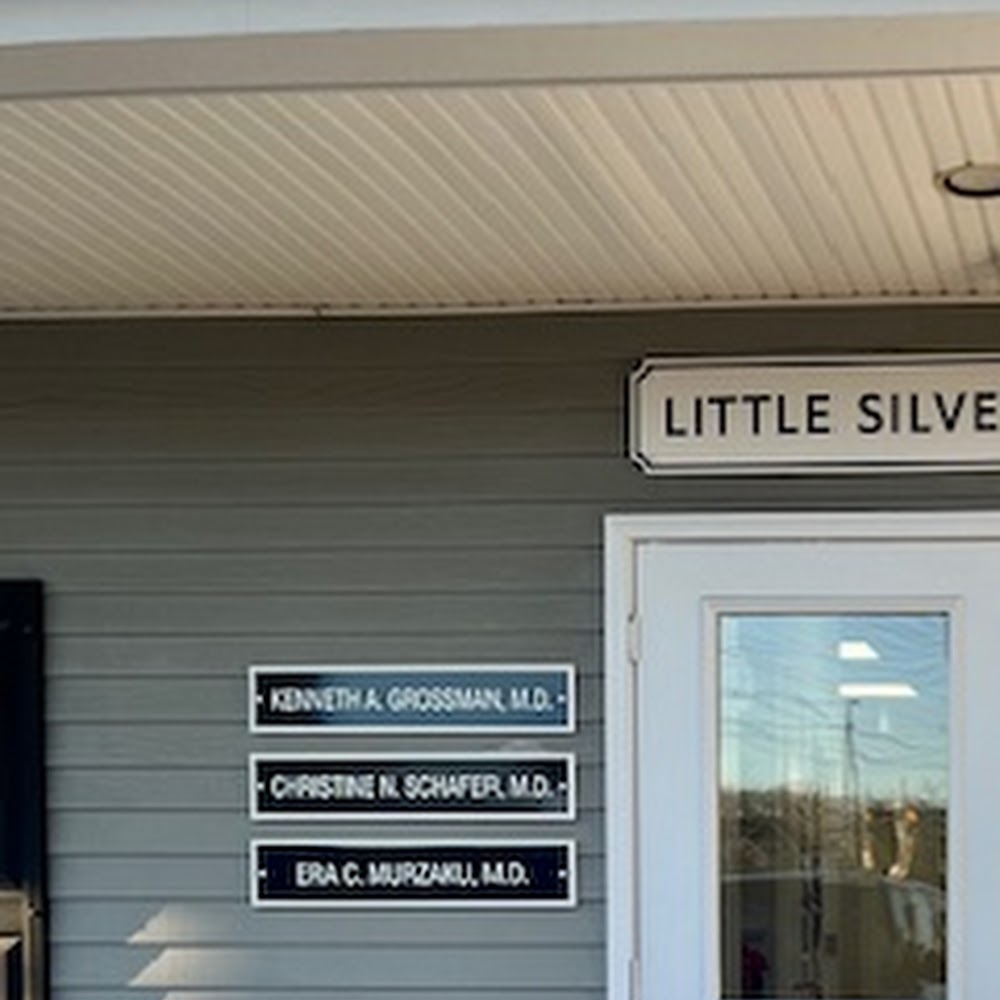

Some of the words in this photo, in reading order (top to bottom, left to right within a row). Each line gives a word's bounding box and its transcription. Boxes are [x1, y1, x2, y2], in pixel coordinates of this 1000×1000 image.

[664, 394, 831, 437] LITTLE
[270, 686, 363, 712] KENNETH
[386, 686, 506, 713] GROSSMAN,
[511, 687, 554, 711] M.D.
[270, 773, 375, 799] CHRISTINE
[404, 774, 506, 800] SCHAFER,
[511, 774, 554, 799] M.D.
[296, 861, 339, 886] ERA
[342, 861, 363, 887] C.
[369, 861, 478, 887] MURZAKU,
[483, 861, 530, 886] M.D.
